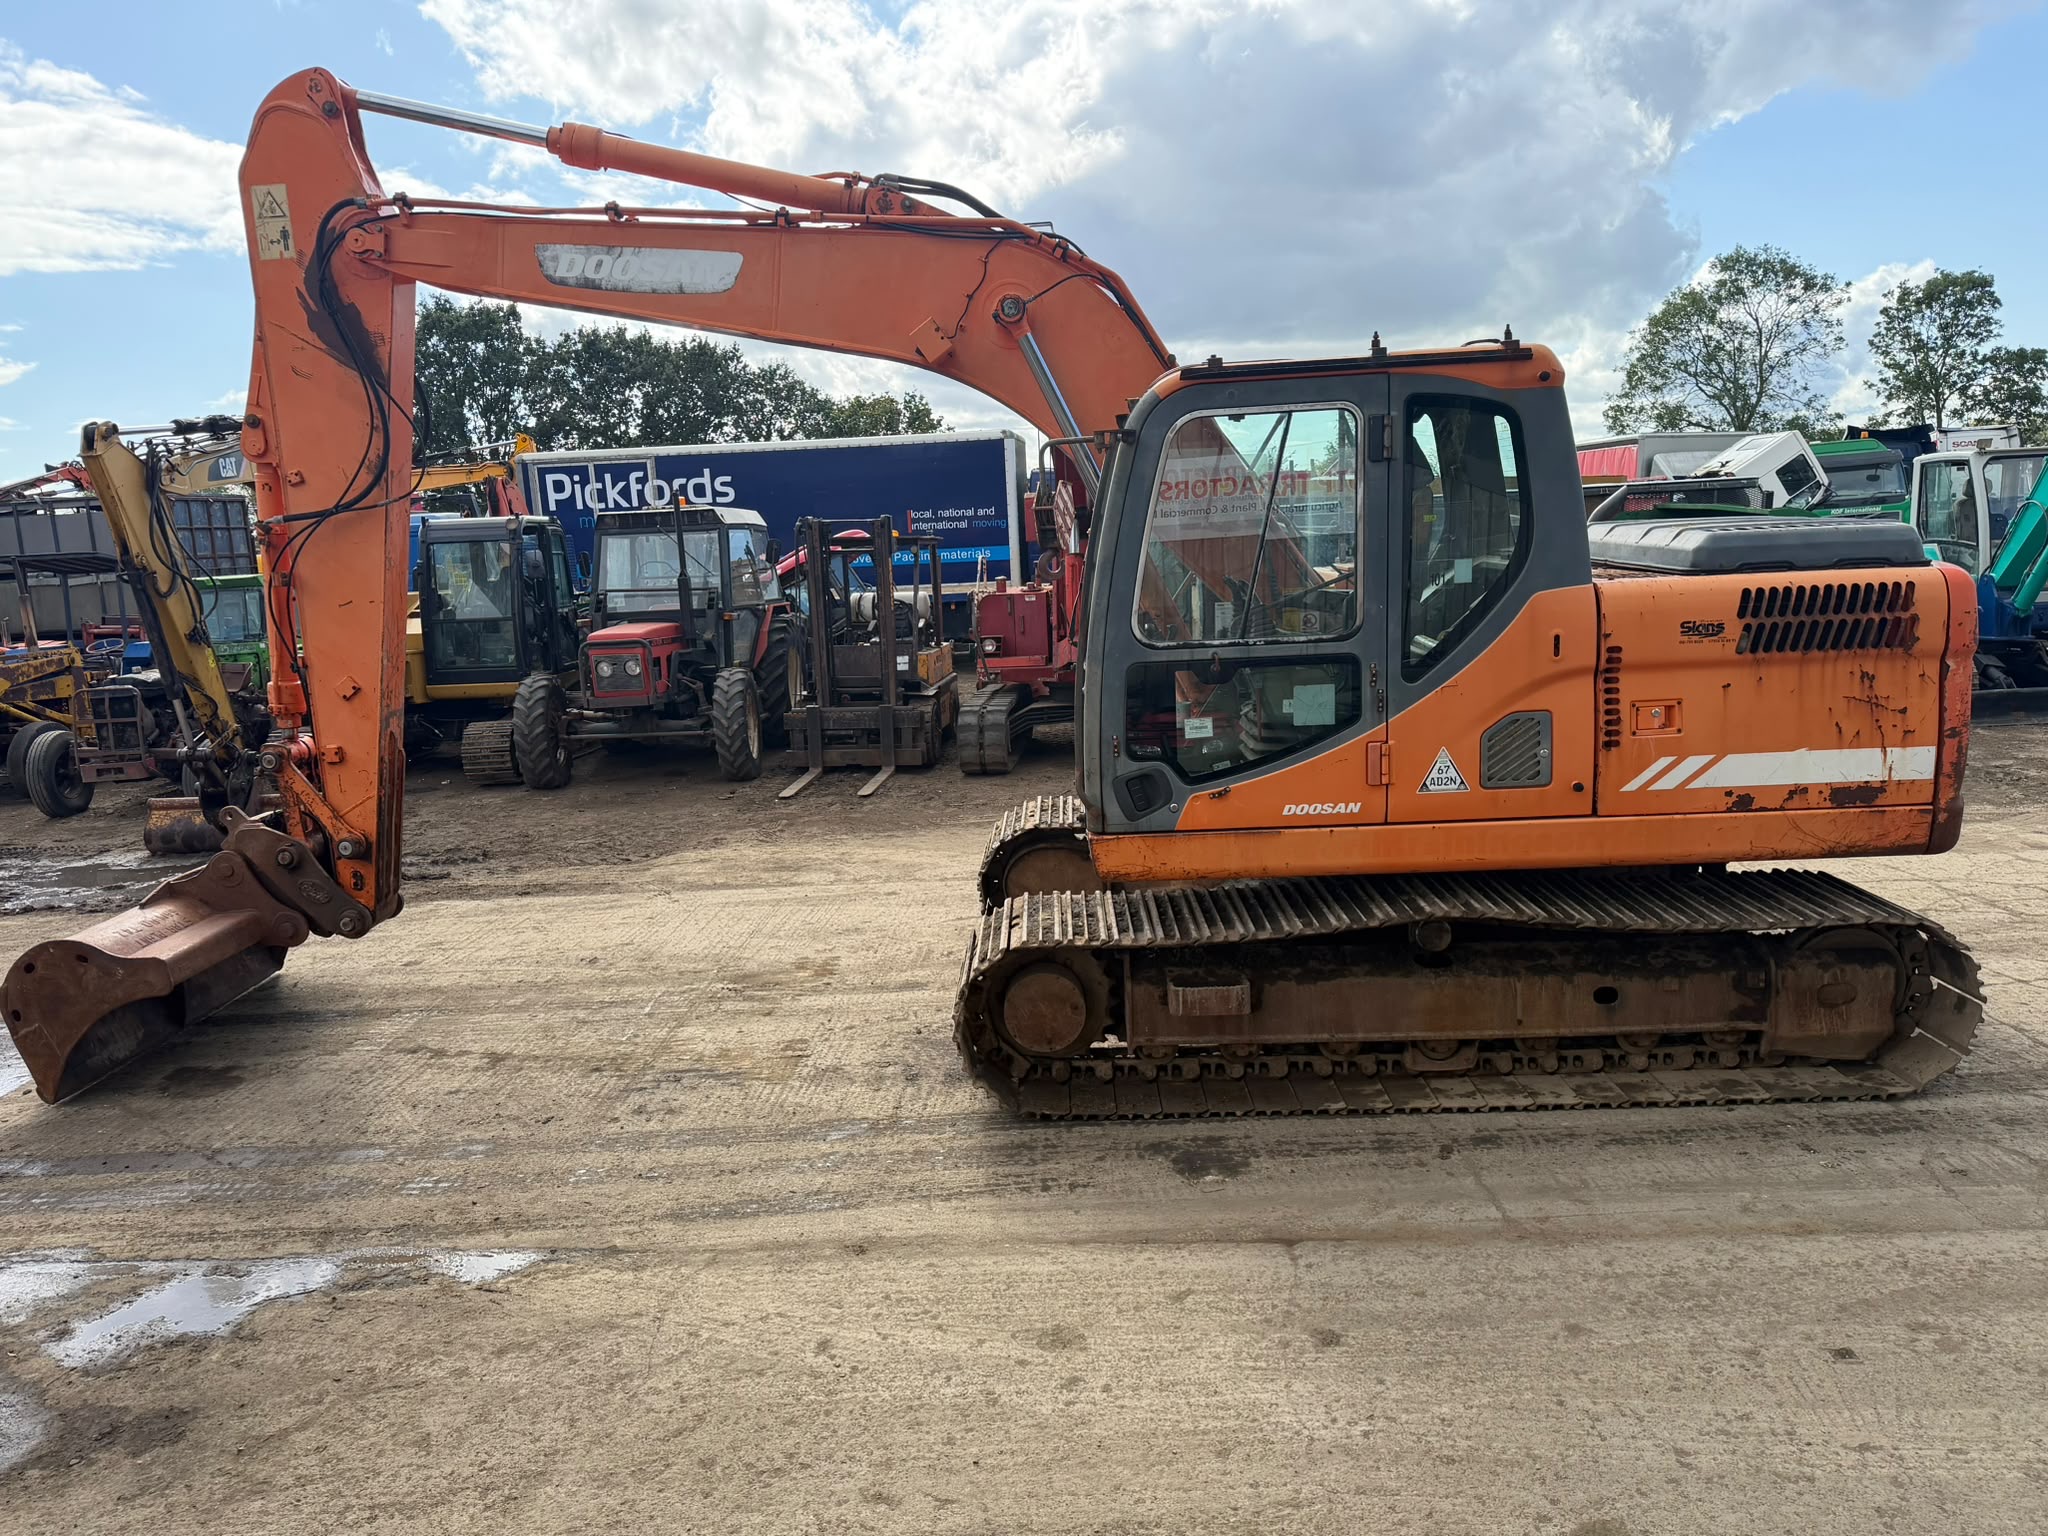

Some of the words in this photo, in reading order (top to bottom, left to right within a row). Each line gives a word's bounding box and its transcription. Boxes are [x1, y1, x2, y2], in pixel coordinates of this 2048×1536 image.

[218, 457, 238, 478] CAT
[545, 467, 736, 511] Pickfords
[910, 509, 935, 520] local,
[937, 507, 974, 519] national
[977, 506, 995, 517] and
[911, 519, 968, 530] international
[972, 518, 1007, 529] moving
[940, 548, 991, 560] materials
[1437, 765, 1450, 775] 67
[1430, 775, 1457, 787] AD2N
[1282, 802, 1362, 816] DOOSAN
